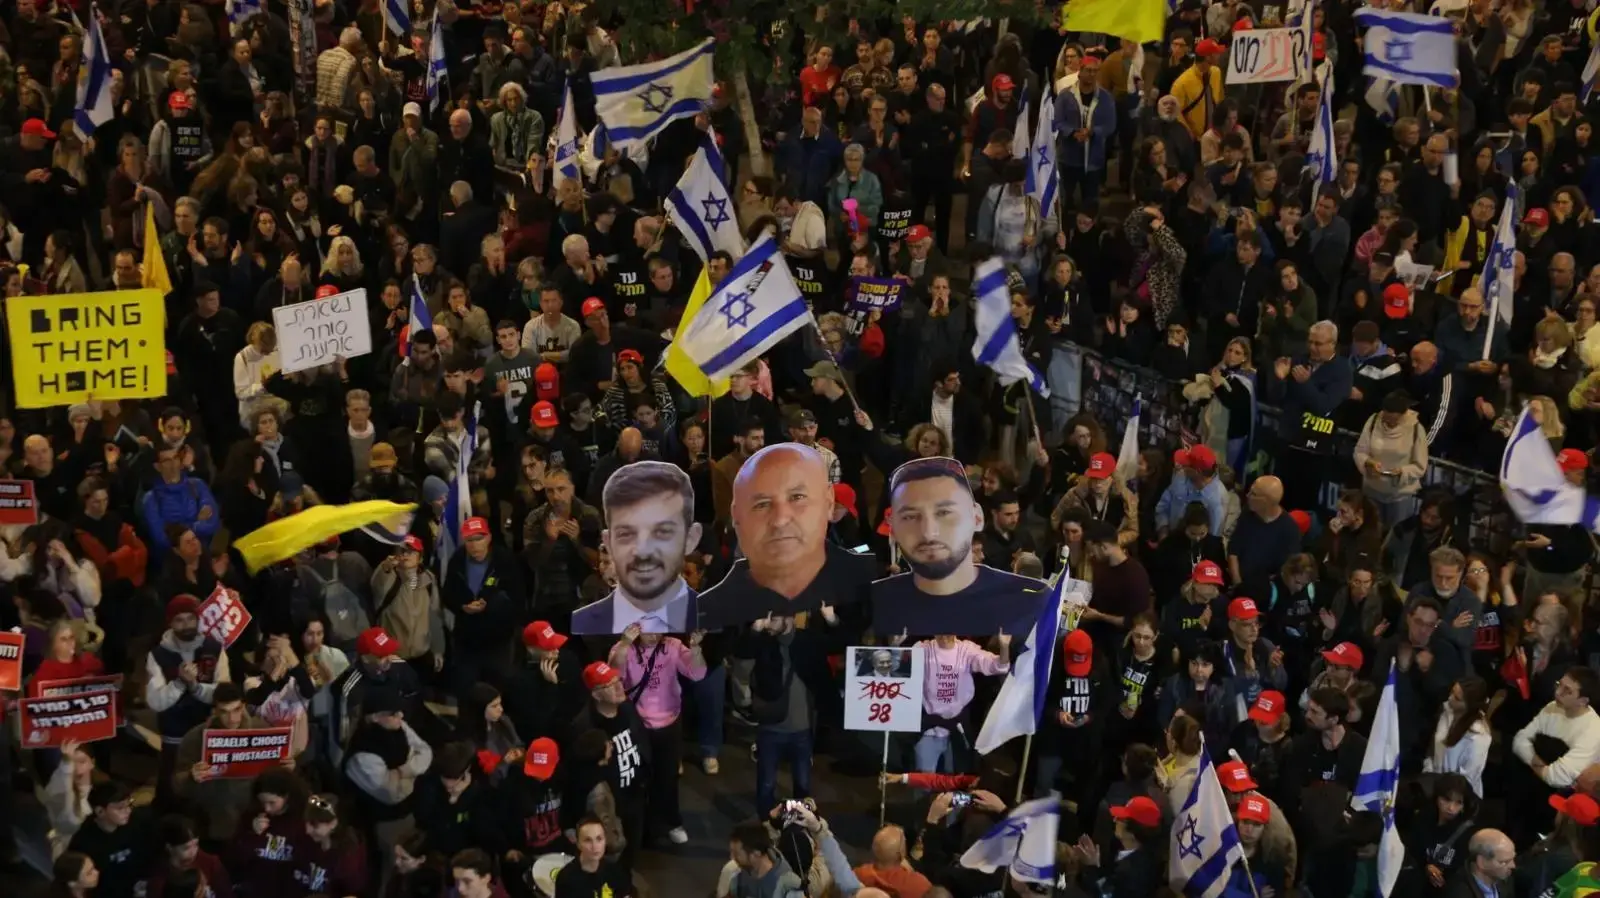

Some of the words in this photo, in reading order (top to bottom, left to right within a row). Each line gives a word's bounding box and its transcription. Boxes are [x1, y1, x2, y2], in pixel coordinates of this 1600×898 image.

[619, 271, 637, 284] עד
[796, 267, 814, 280] עד
[614, 283, 645, 296] מתי?
[30, 303, 142, 333] BRING
[303, 320, 348, 341] סוחר
[32, 338, 129, 363] THEM
[293, 336, 353, 363] ארונות
[39, 365, 149, 394] HOME!
[1302, 411, 1334, 434] מתי?
[861, 680, 901, 699] 100
[868, 703, 892, 723] 98
[207, 737, 249, 749] ISRAELIS
[251, 735, 289, 747] CHOOSE
[212, 752, 230, 764] THE
[231, 746, 282, 762] HOSTAGES!
